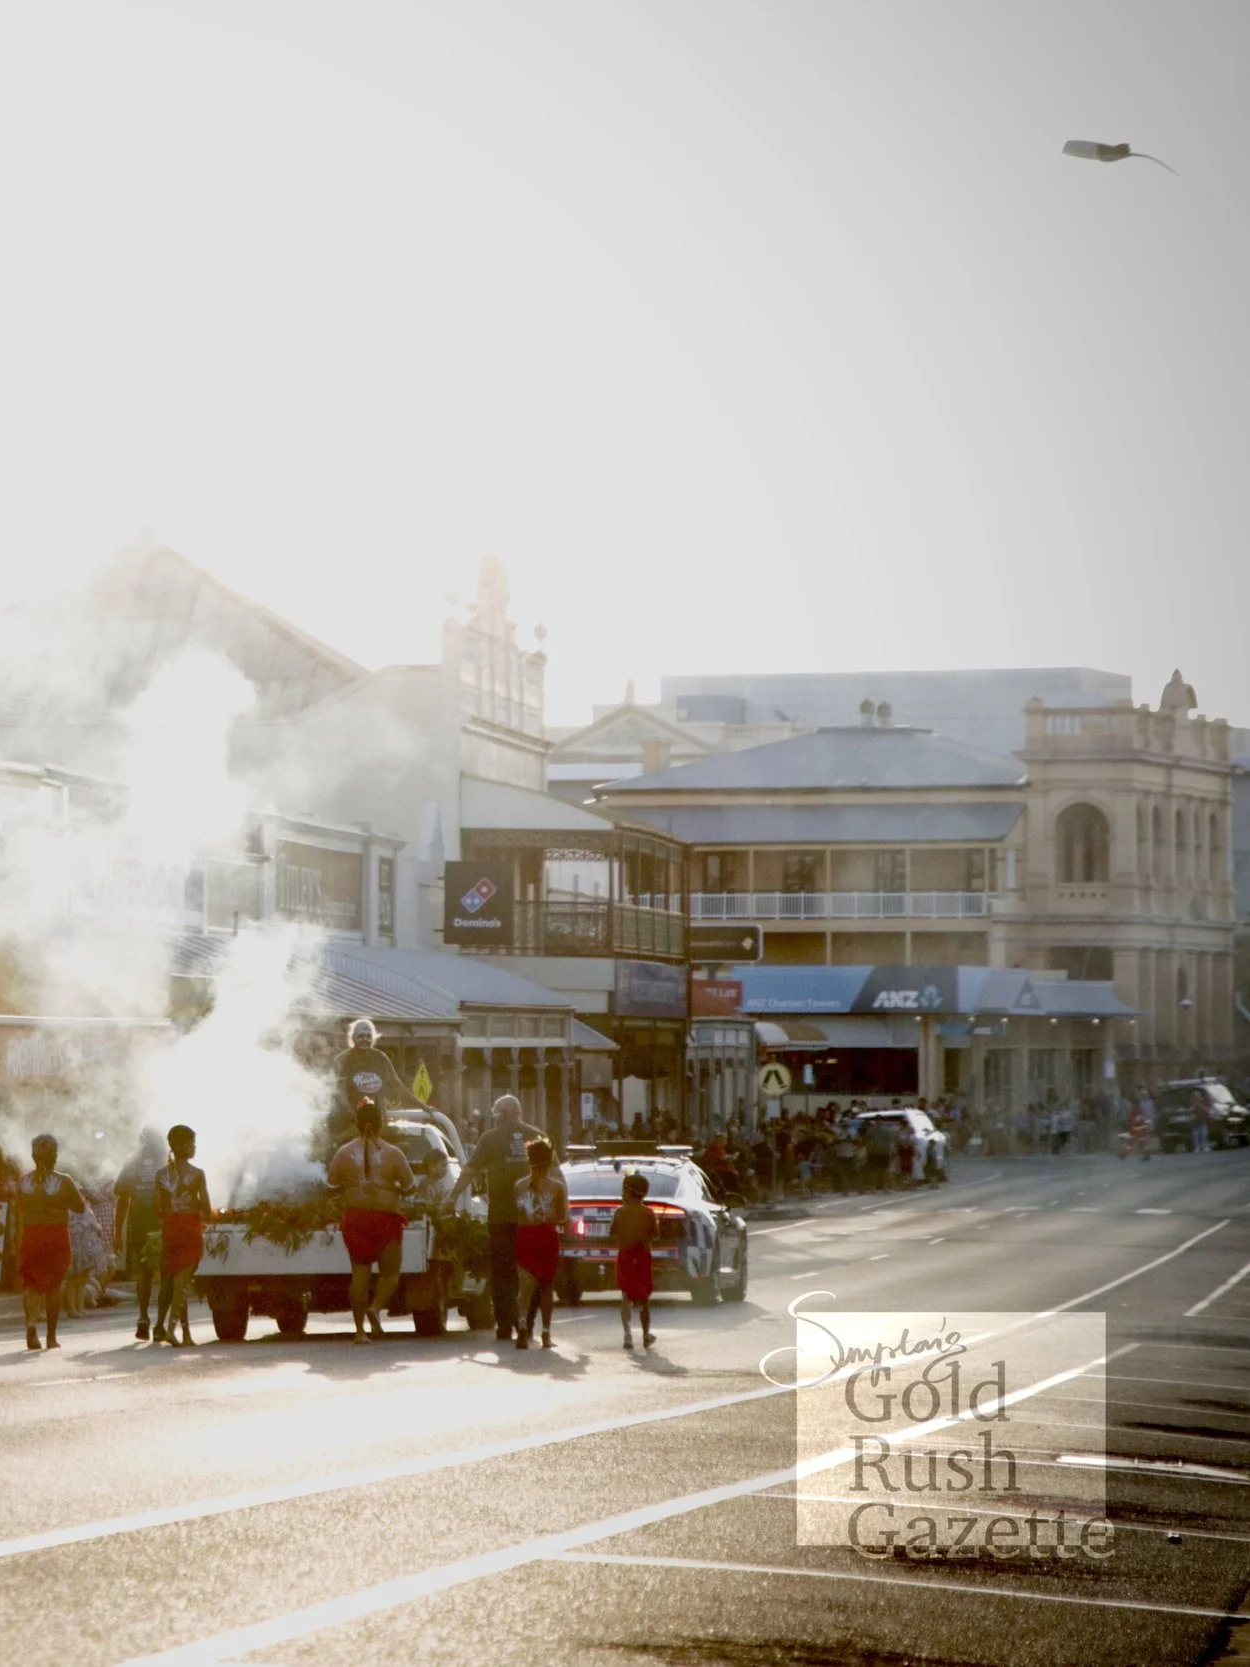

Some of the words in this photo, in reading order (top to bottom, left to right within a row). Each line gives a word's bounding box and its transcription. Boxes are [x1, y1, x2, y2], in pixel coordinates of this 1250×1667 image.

[453, 917, 502, 929] Domino's
[808, 998, 841, 1009] Towers
[872, 990, 919, 1009] ANZ
